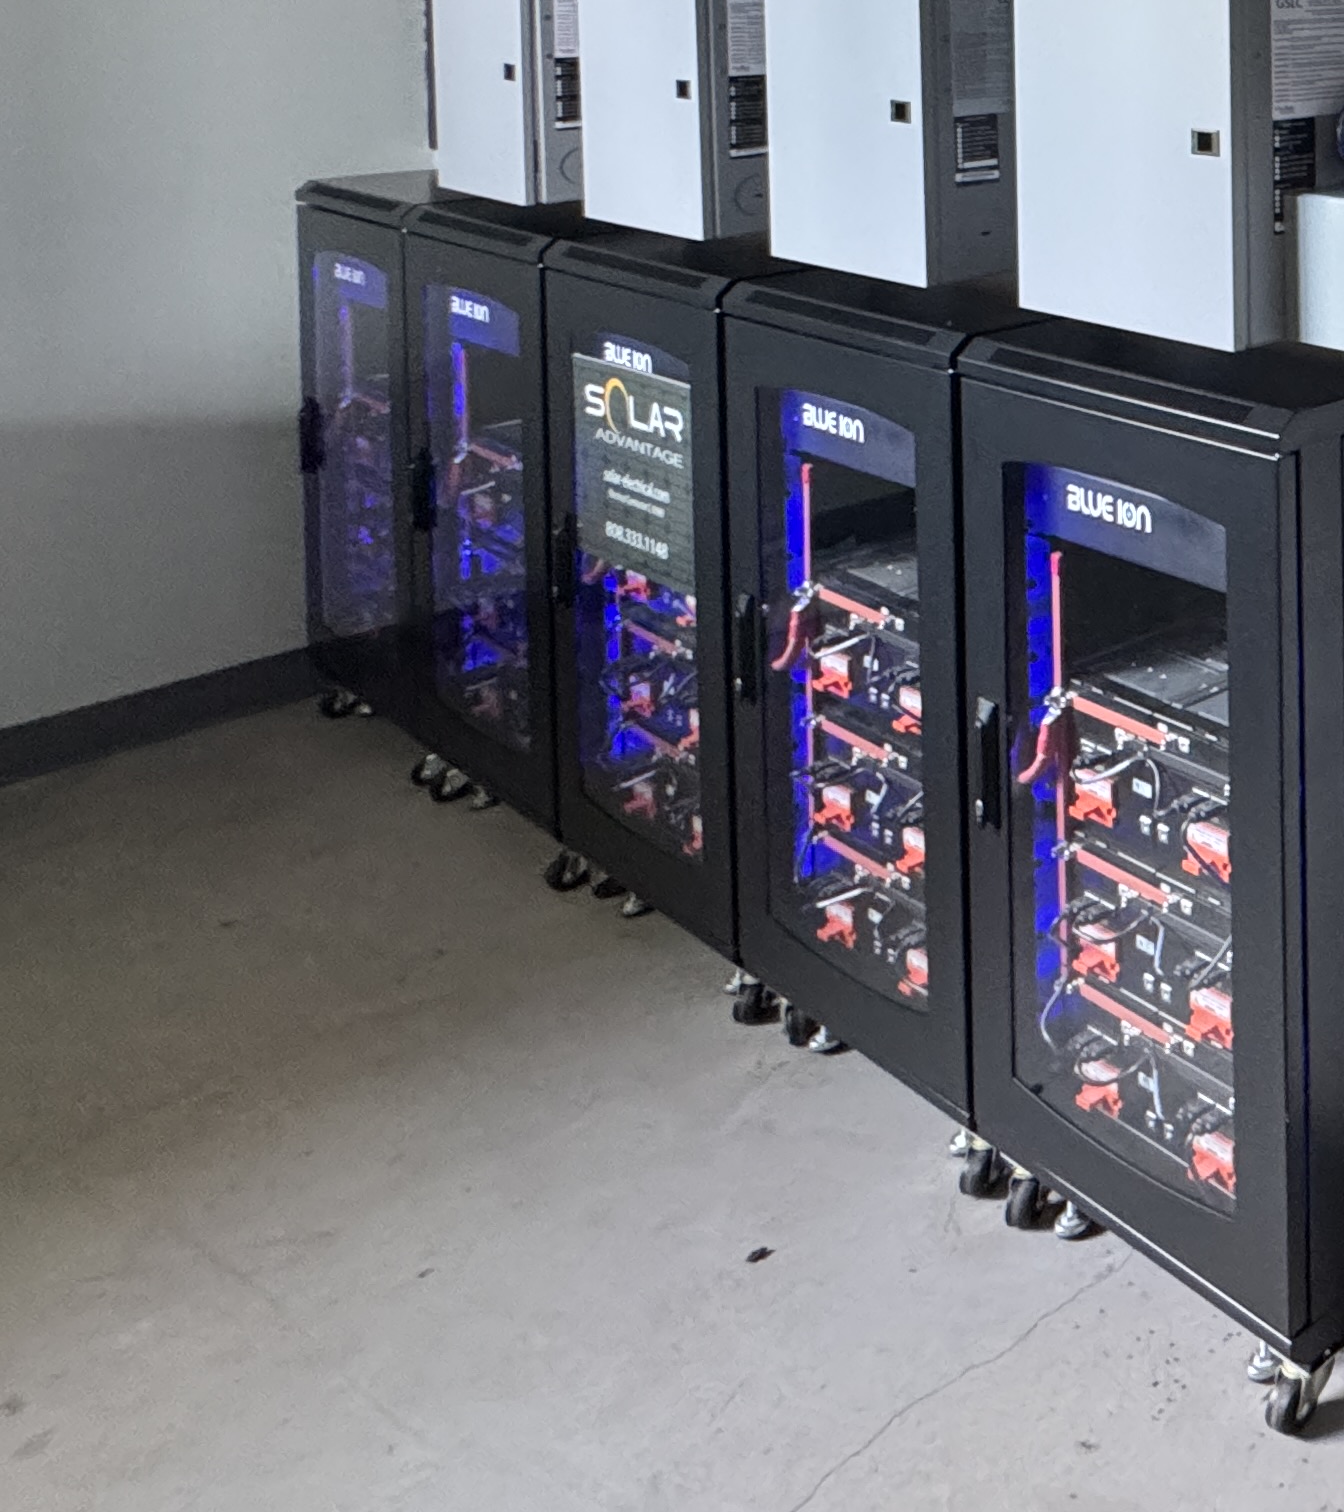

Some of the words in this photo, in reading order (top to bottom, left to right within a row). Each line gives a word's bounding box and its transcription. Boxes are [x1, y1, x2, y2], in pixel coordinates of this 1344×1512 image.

[584, 377, 684, 443] SOLAR
[802, 402, 838, 435] BLUE
[838, 414, 865, 444] ION
[594, 427, 685, 469] ADVANTAGE
[1066, 483, 1115, 523] BLUE
[1116, 498, 1152, 534] ION
